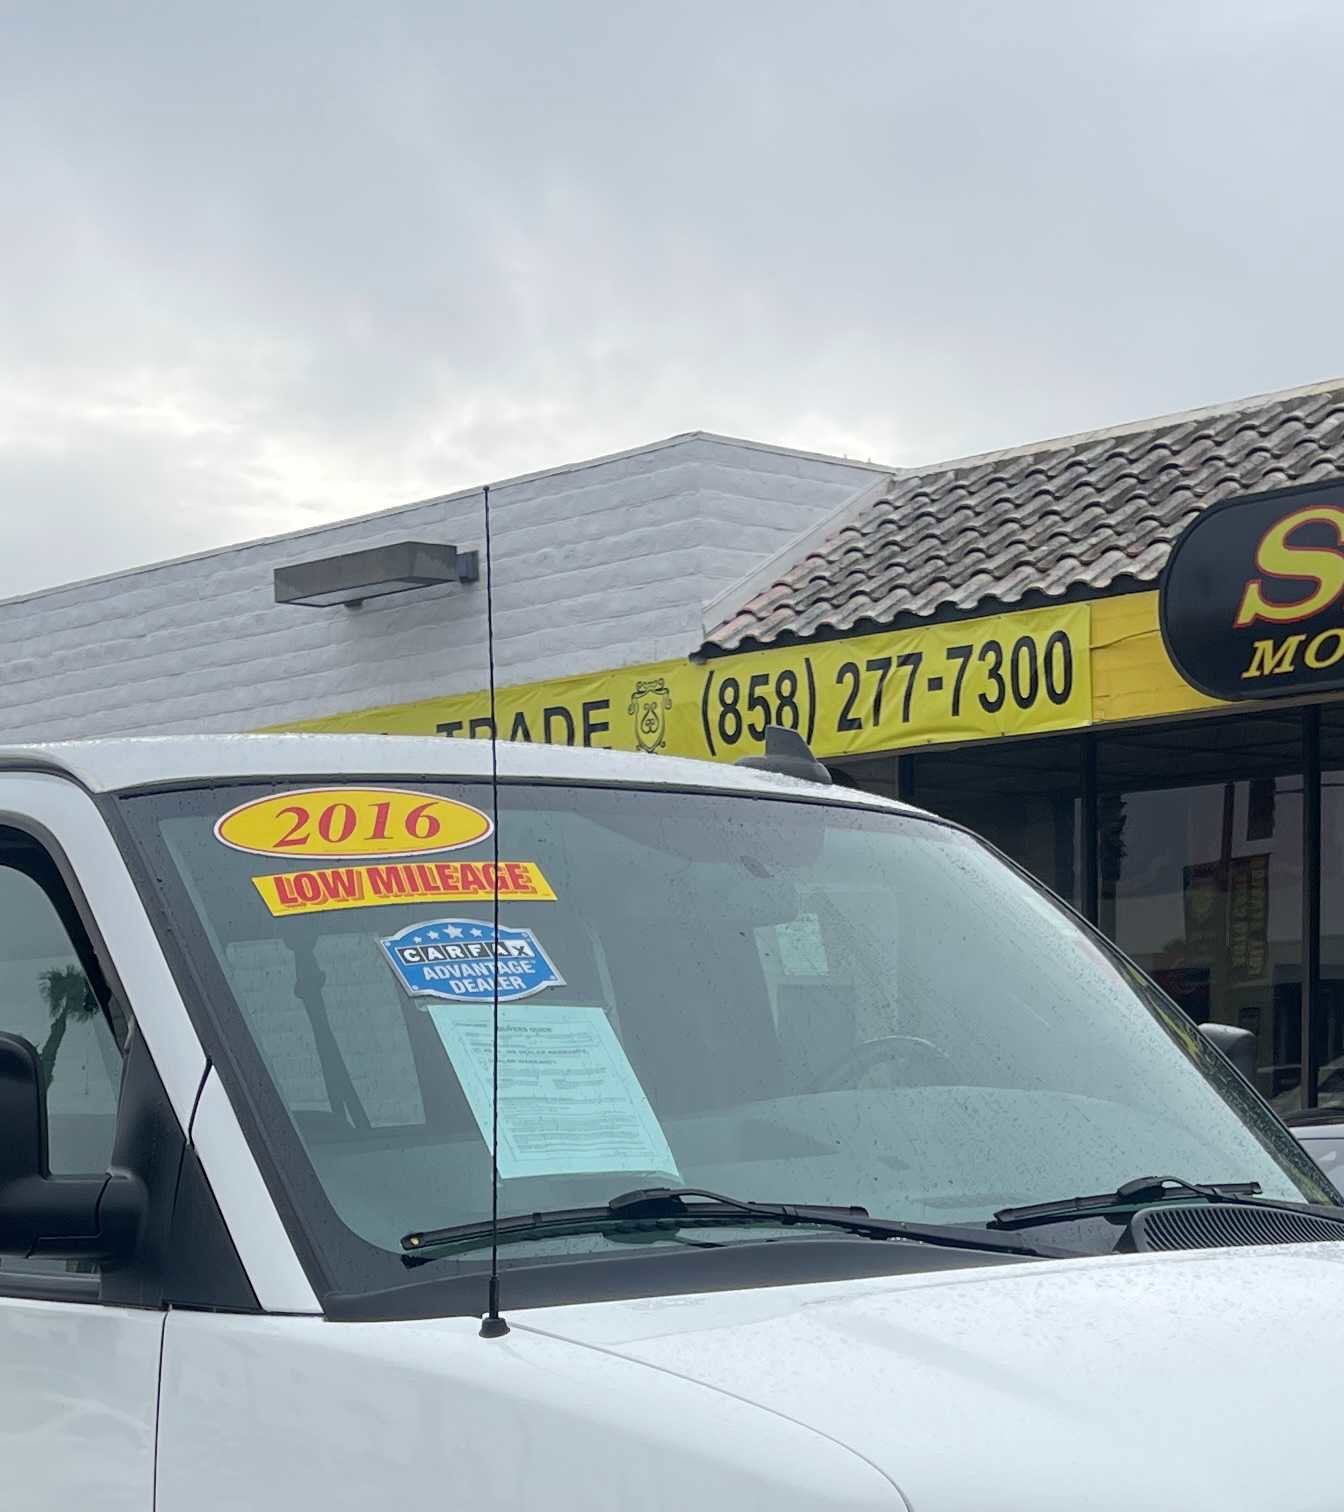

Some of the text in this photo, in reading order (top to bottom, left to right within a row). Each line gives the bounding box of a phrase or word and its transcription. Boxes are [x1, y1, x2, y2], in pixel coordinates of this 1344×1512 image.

[701, 657, 816, 757] (858)
[835, 630, 1074, 733] 277-7300
[272, 801, 440, 848] 2016
[273, 862, 537, 908] LOW MILEAGE
[402, 942, 533, 965] CARFAX
[422, 961, 535, 981] ADVANTAGE
[449, 976, 527, 994] DEALER
